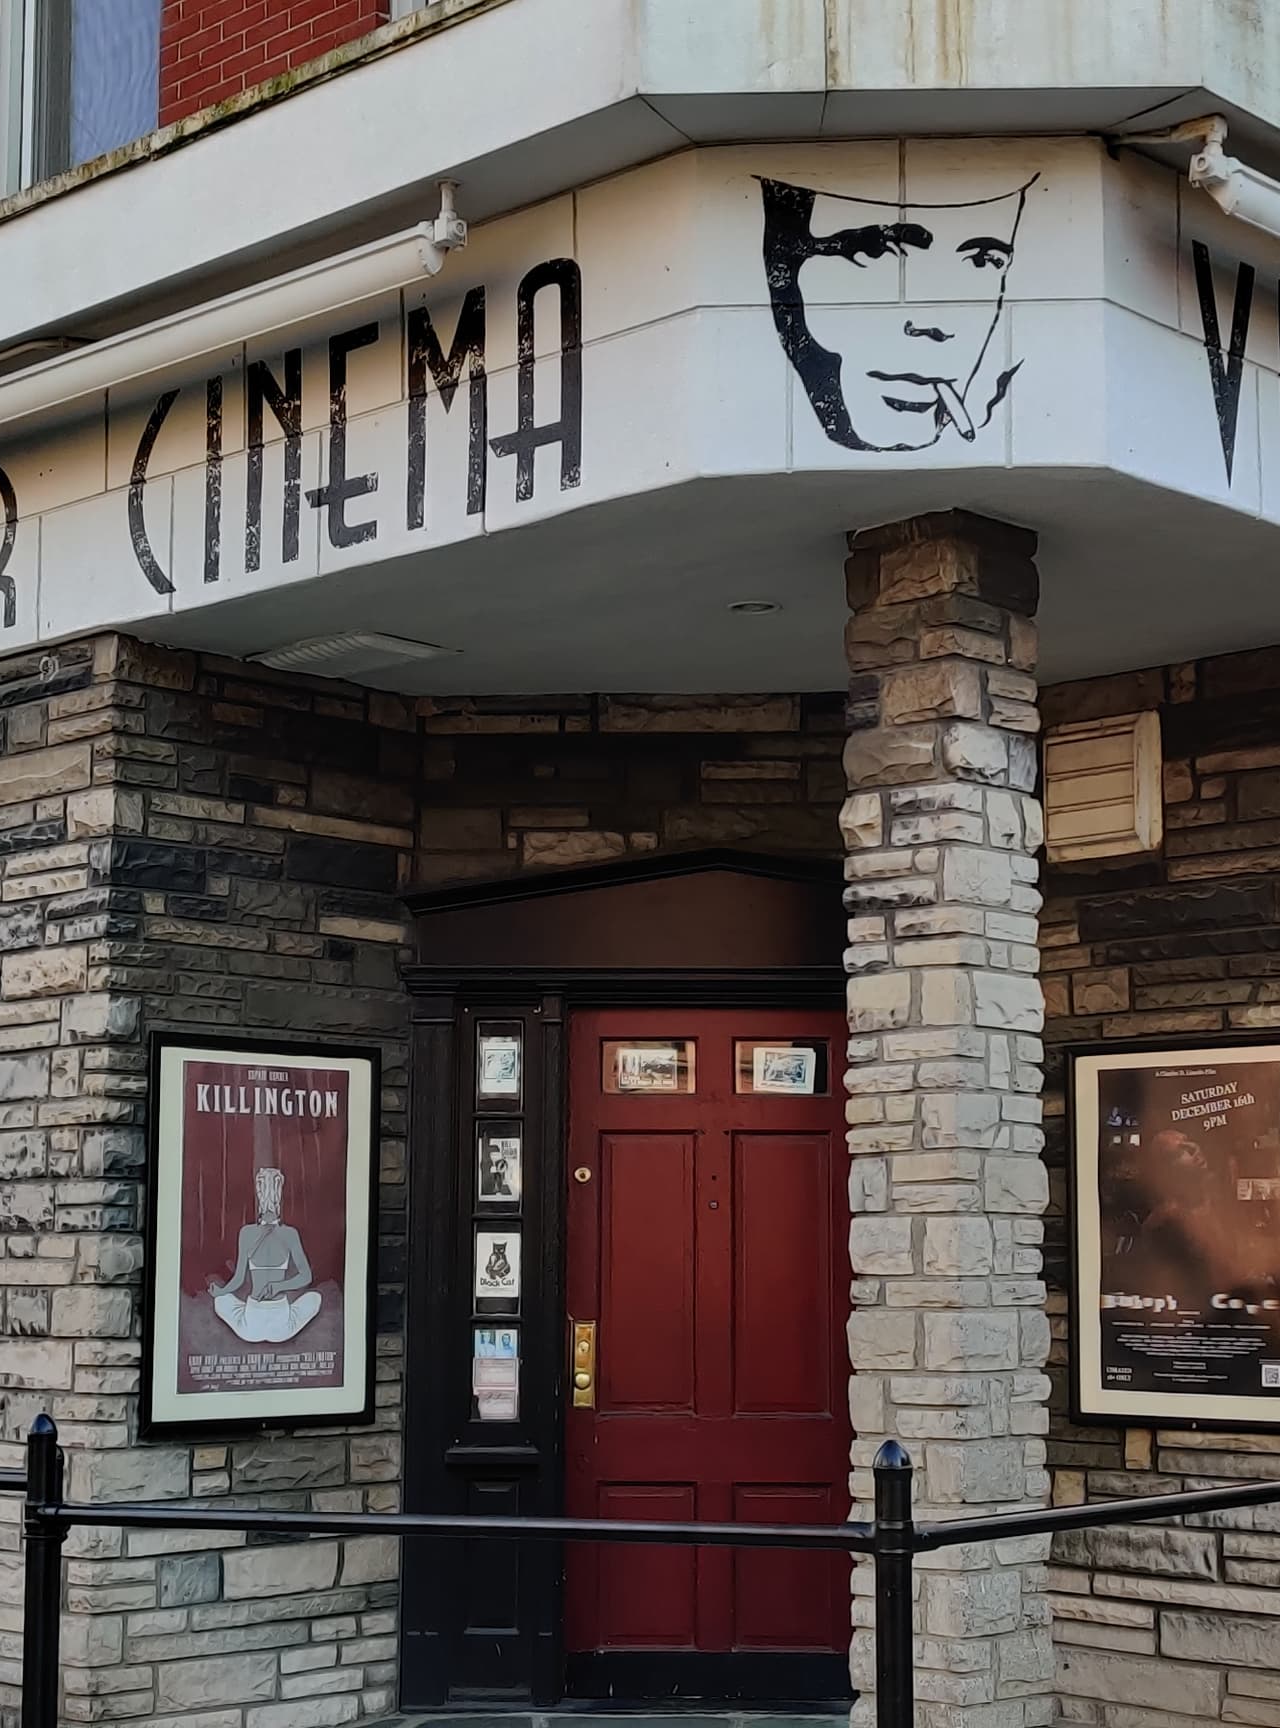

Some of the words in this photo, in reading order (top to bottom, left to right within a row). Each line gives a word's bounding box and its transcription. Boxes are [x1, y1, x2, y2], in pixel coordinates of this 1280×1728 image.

[129, 257, 584, 595] CINEMA
[196, 1083, 338, 1118] KILLINGTON
[1181, 1081, 1238, 1104] SATURDAY
[1171, 1099, 1232, 1121] DECEMBER
[1203, 1114, 1227, 1131] 9PM
